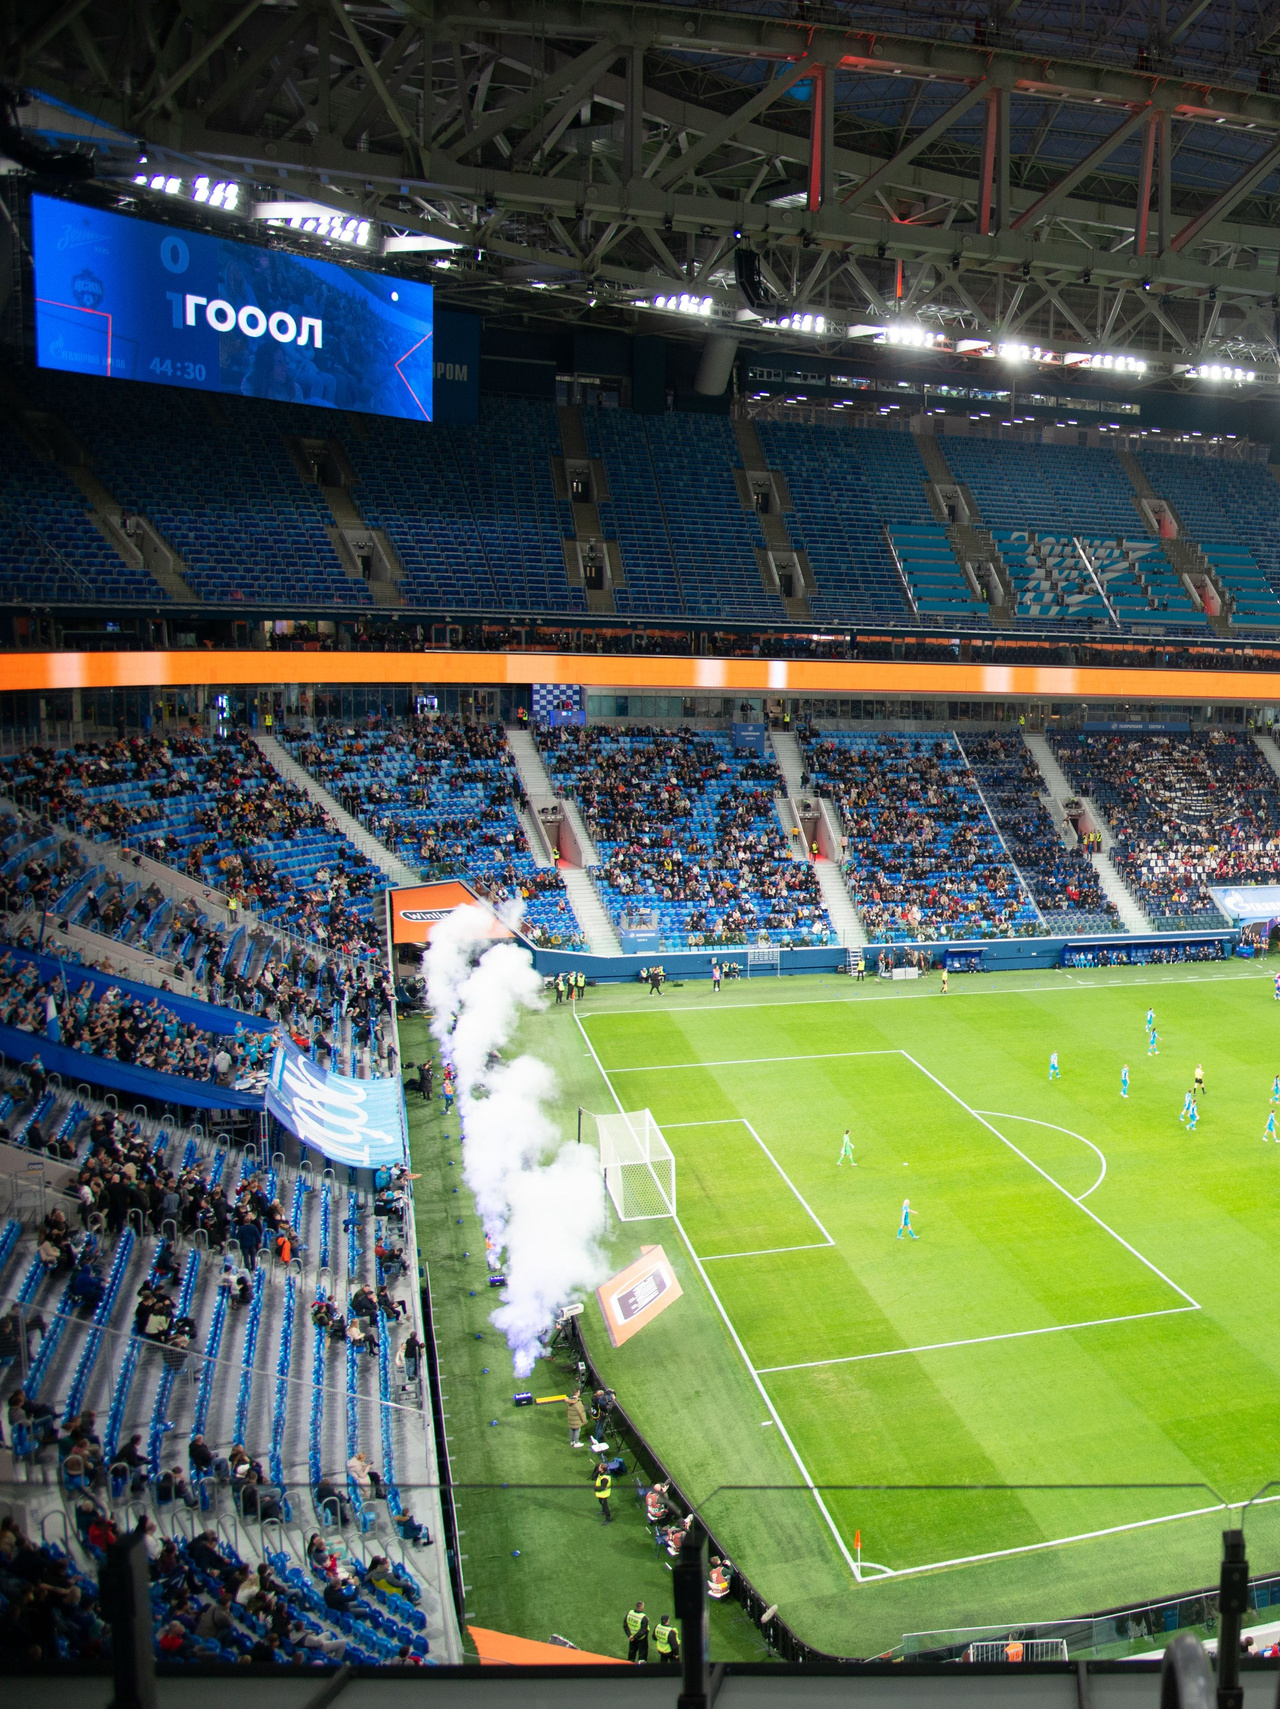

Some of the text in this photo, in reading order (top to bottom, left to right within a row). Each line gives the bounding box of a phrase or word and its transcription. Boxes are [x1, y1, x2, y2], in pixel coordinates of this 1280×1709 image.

[160, 236, 190, 275] 0
[166, 291, 184, 329] 1
[185, 293, 323, 349] ГОООЛ
[150, 357, 206, 382] 44:30
[407, 411, 451, 421] Winlin
